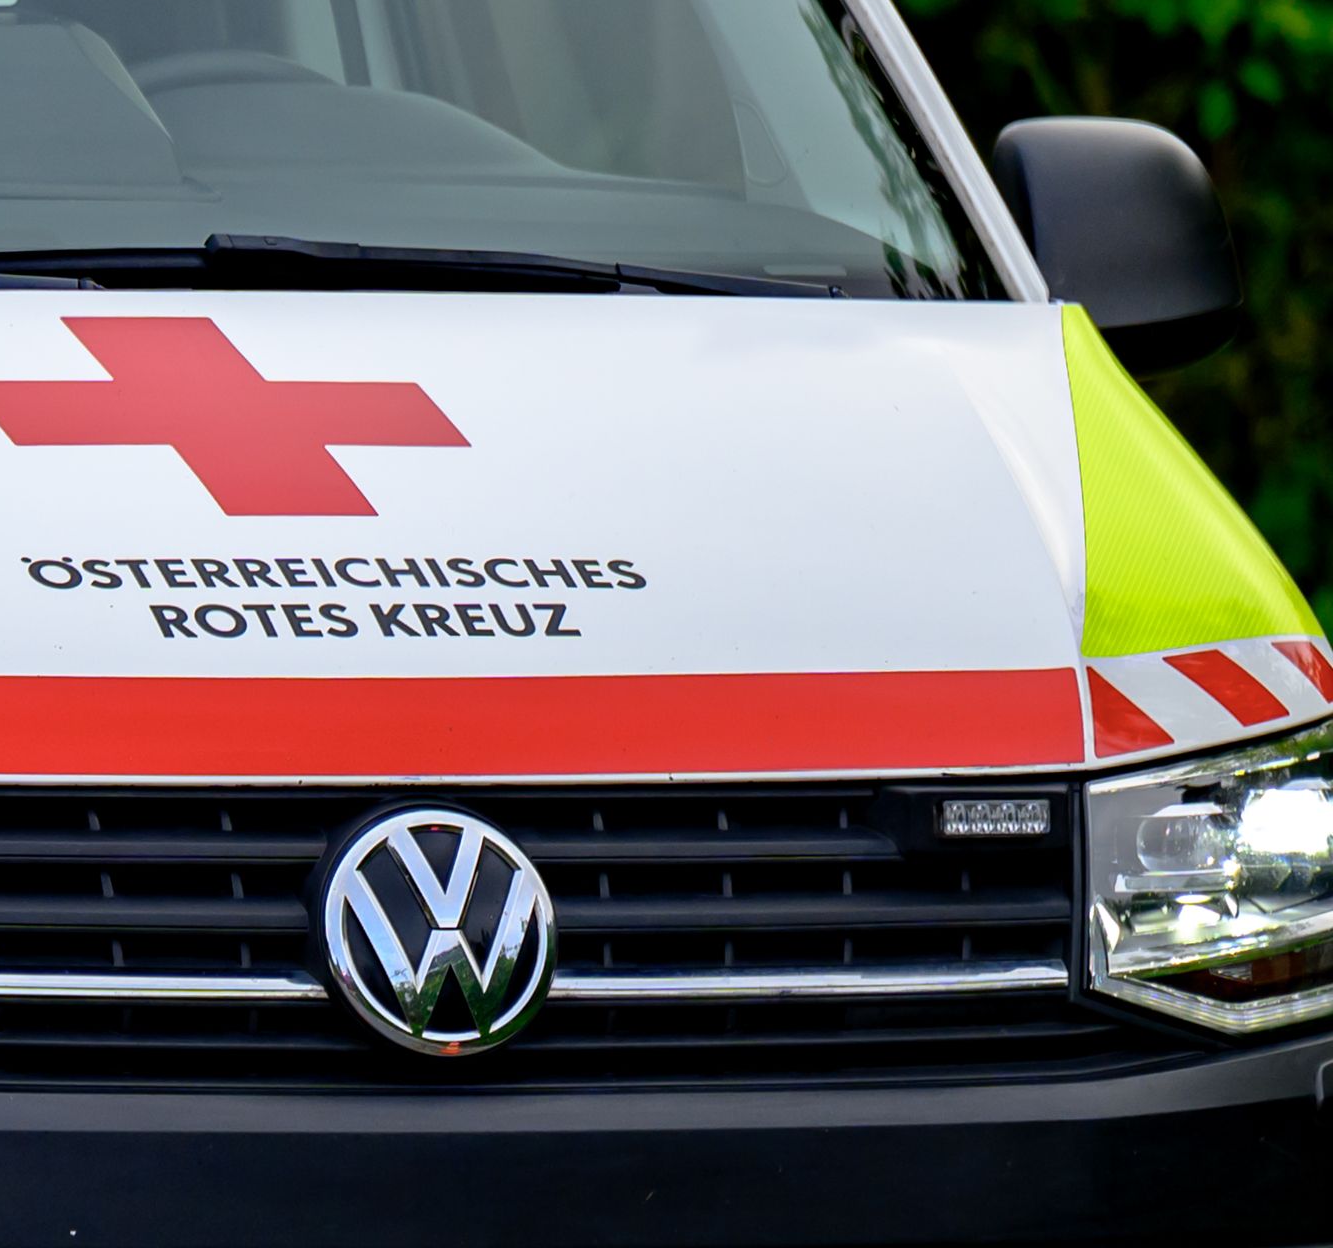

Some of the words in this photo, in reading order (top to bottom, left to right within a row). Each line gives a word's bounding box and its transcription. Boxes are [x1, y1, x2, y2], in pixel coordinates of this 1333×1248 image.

[21, 556, 647, 590] ÖSTERREICHISCHES
[149, 603, 359, 639] ROTES
[369, 603, 582, 638] KREUZ
[325, 810, 556, 1055] VW
